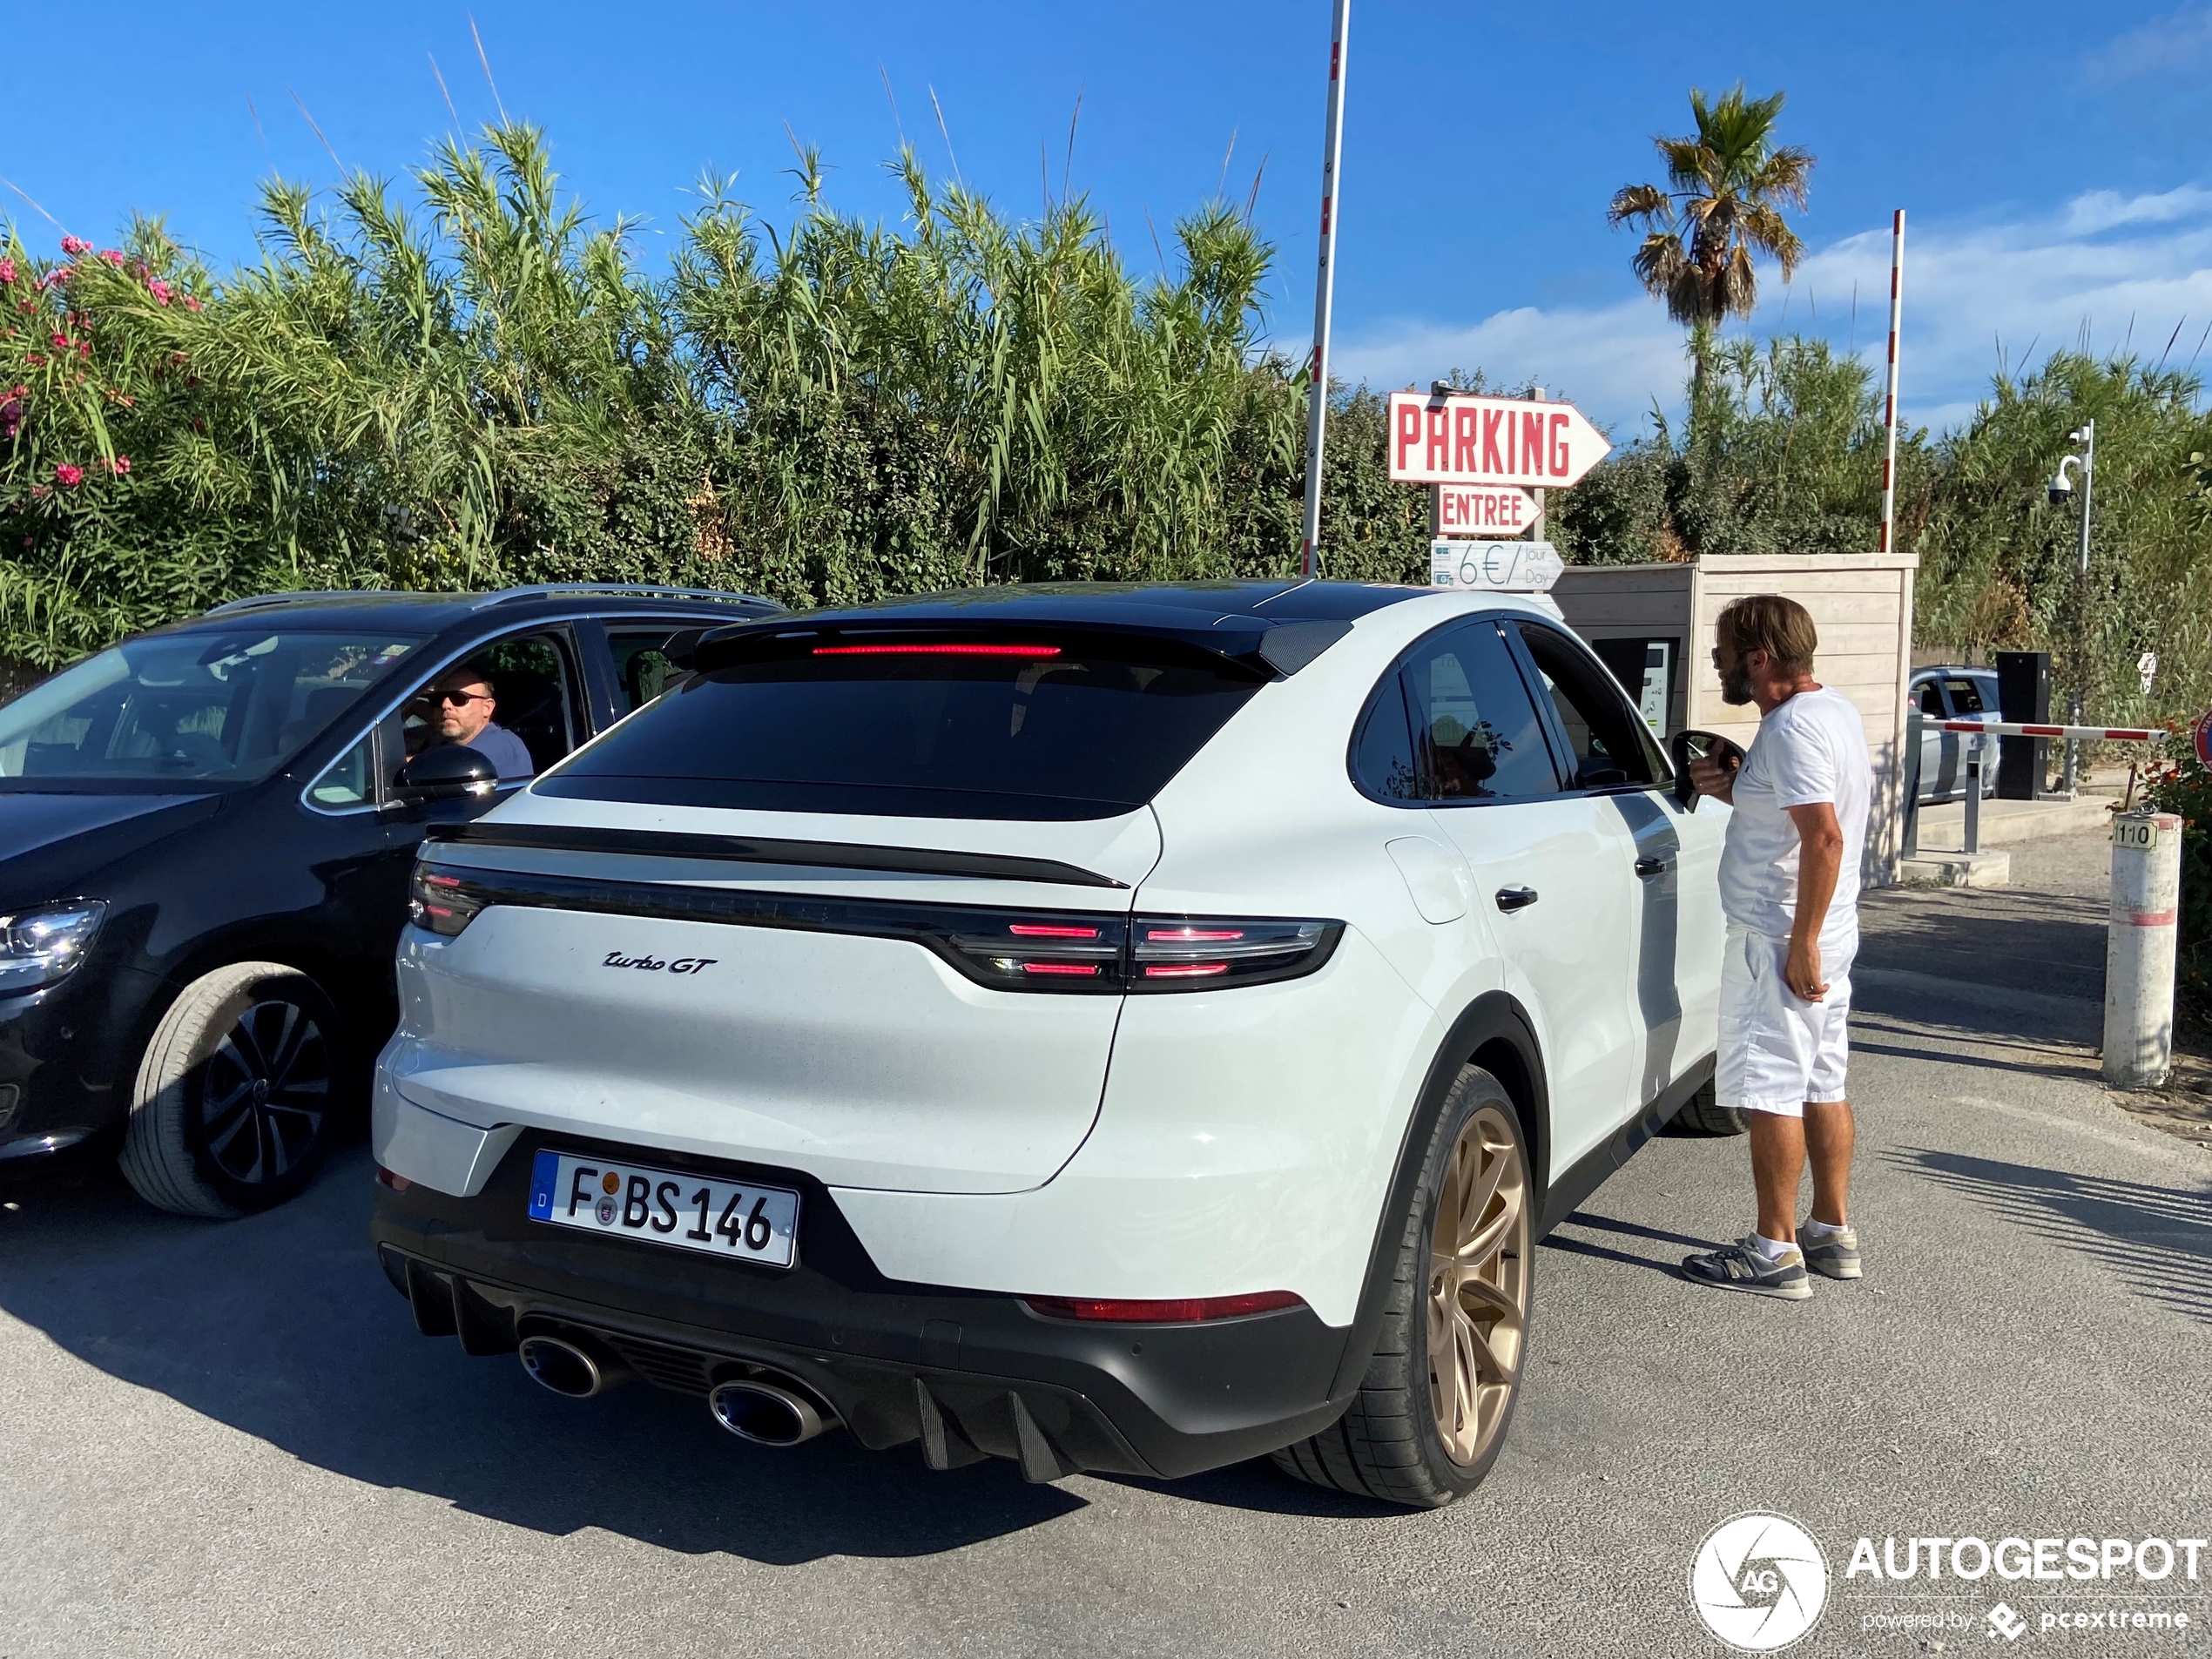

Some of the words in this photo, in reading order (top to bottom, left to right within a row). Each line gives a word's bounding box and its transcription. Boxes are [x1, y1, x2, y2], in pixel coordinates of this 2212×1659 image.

[1397, 404, 1569, 477] PARKING
[1525, 569, 1548, 585] Day
[2120, 824, 2149, 844] 110
[603, 951, 665, 971] turbo
[668, 958, 718, 974] GT
